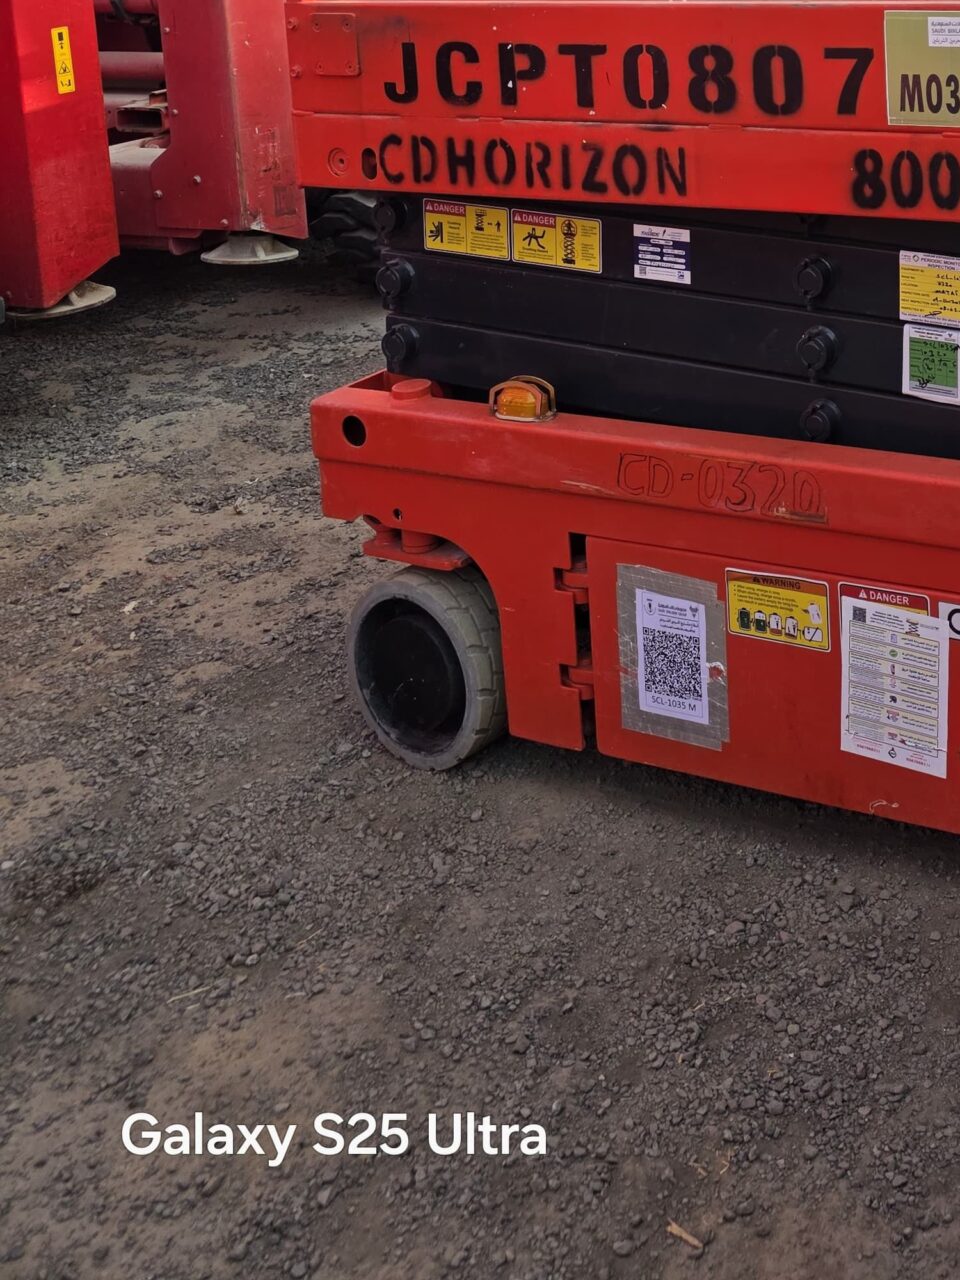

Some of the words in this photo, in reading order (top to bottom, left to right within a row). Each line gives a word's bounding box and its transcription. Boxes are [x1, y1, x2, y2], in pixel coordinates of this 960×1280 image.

[384, 40, 874, 116] JCPT0807
[433, 203, 465, 214] DANGER
[522, 215, 555, 226] DANGER
[762, 578, 801, 590] WARNING
[869, 591, 909, 606] DANGER
[651, 695, 686, 710] SCL-1035
[688, 703, 697, 712] M
